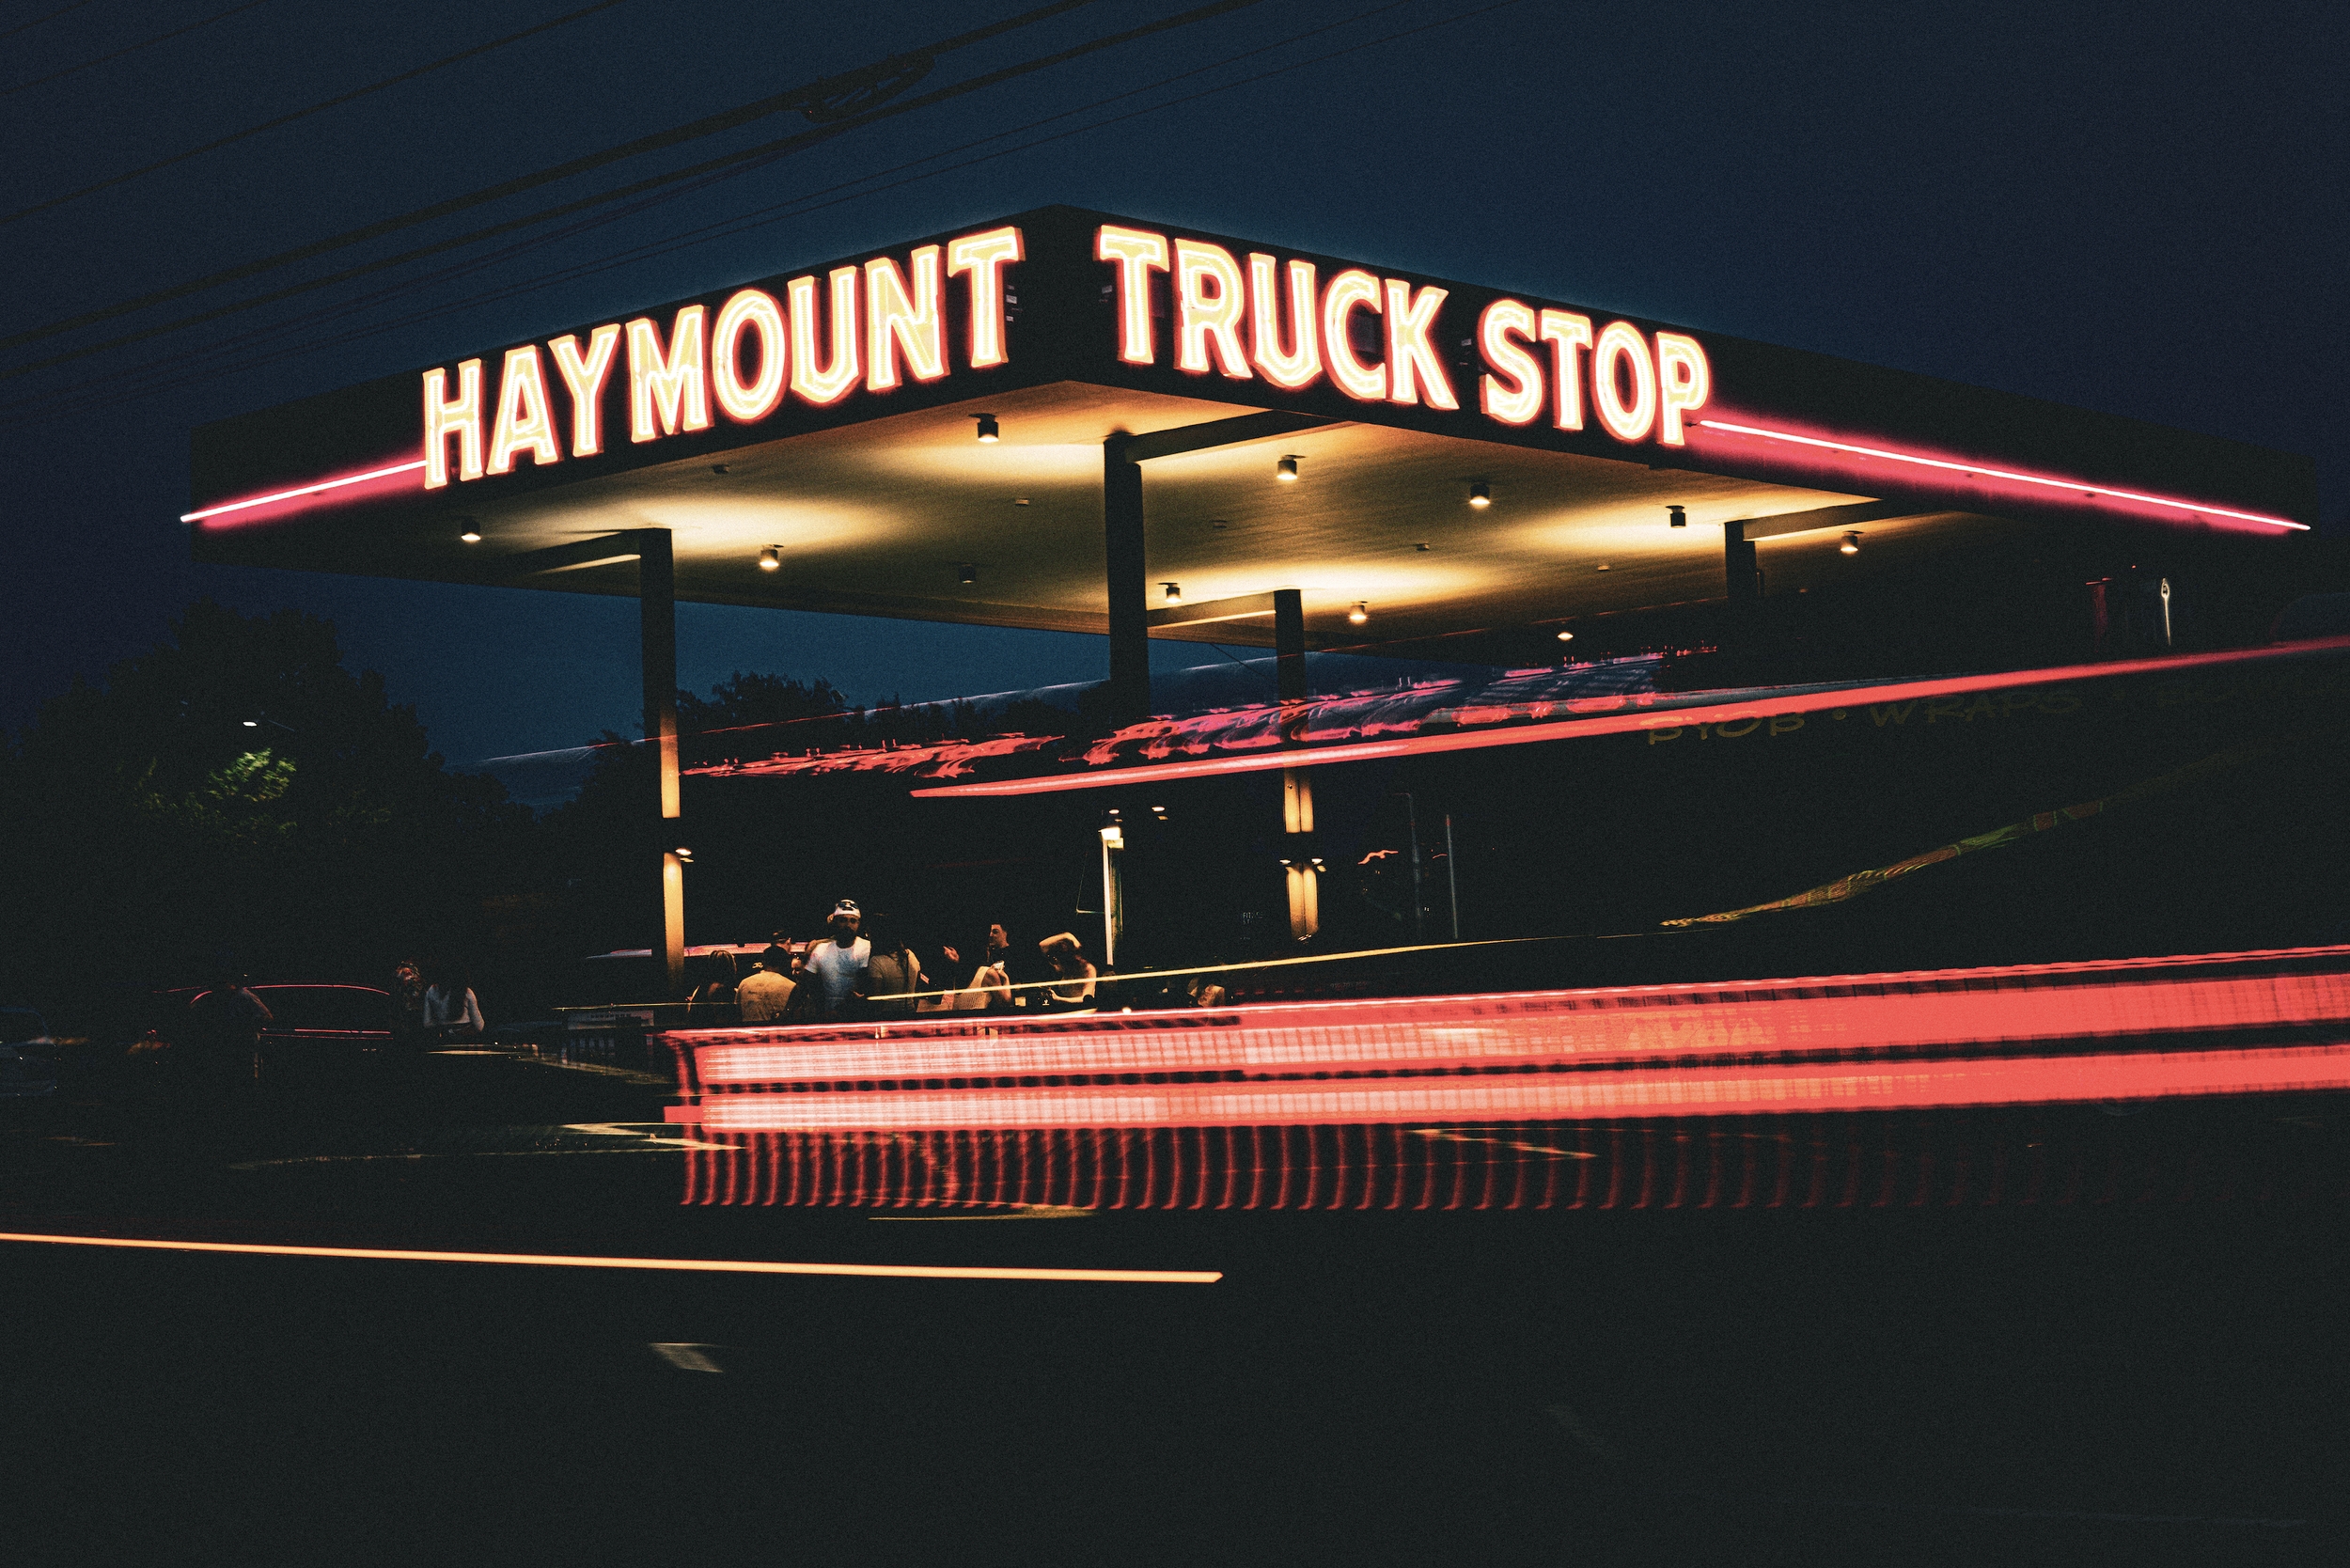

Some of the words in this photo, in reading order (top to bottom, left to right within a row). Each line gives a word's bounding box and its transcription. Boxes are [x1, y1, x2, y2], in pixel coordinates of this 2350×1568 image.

[422, 226, 1026, 490] HAYMOUNT
[1094, 224, 1460, 411] TRUCK
[1479, 298, 1710, 447] STOP
[1867, 688, 2082, 728] WRAPS
